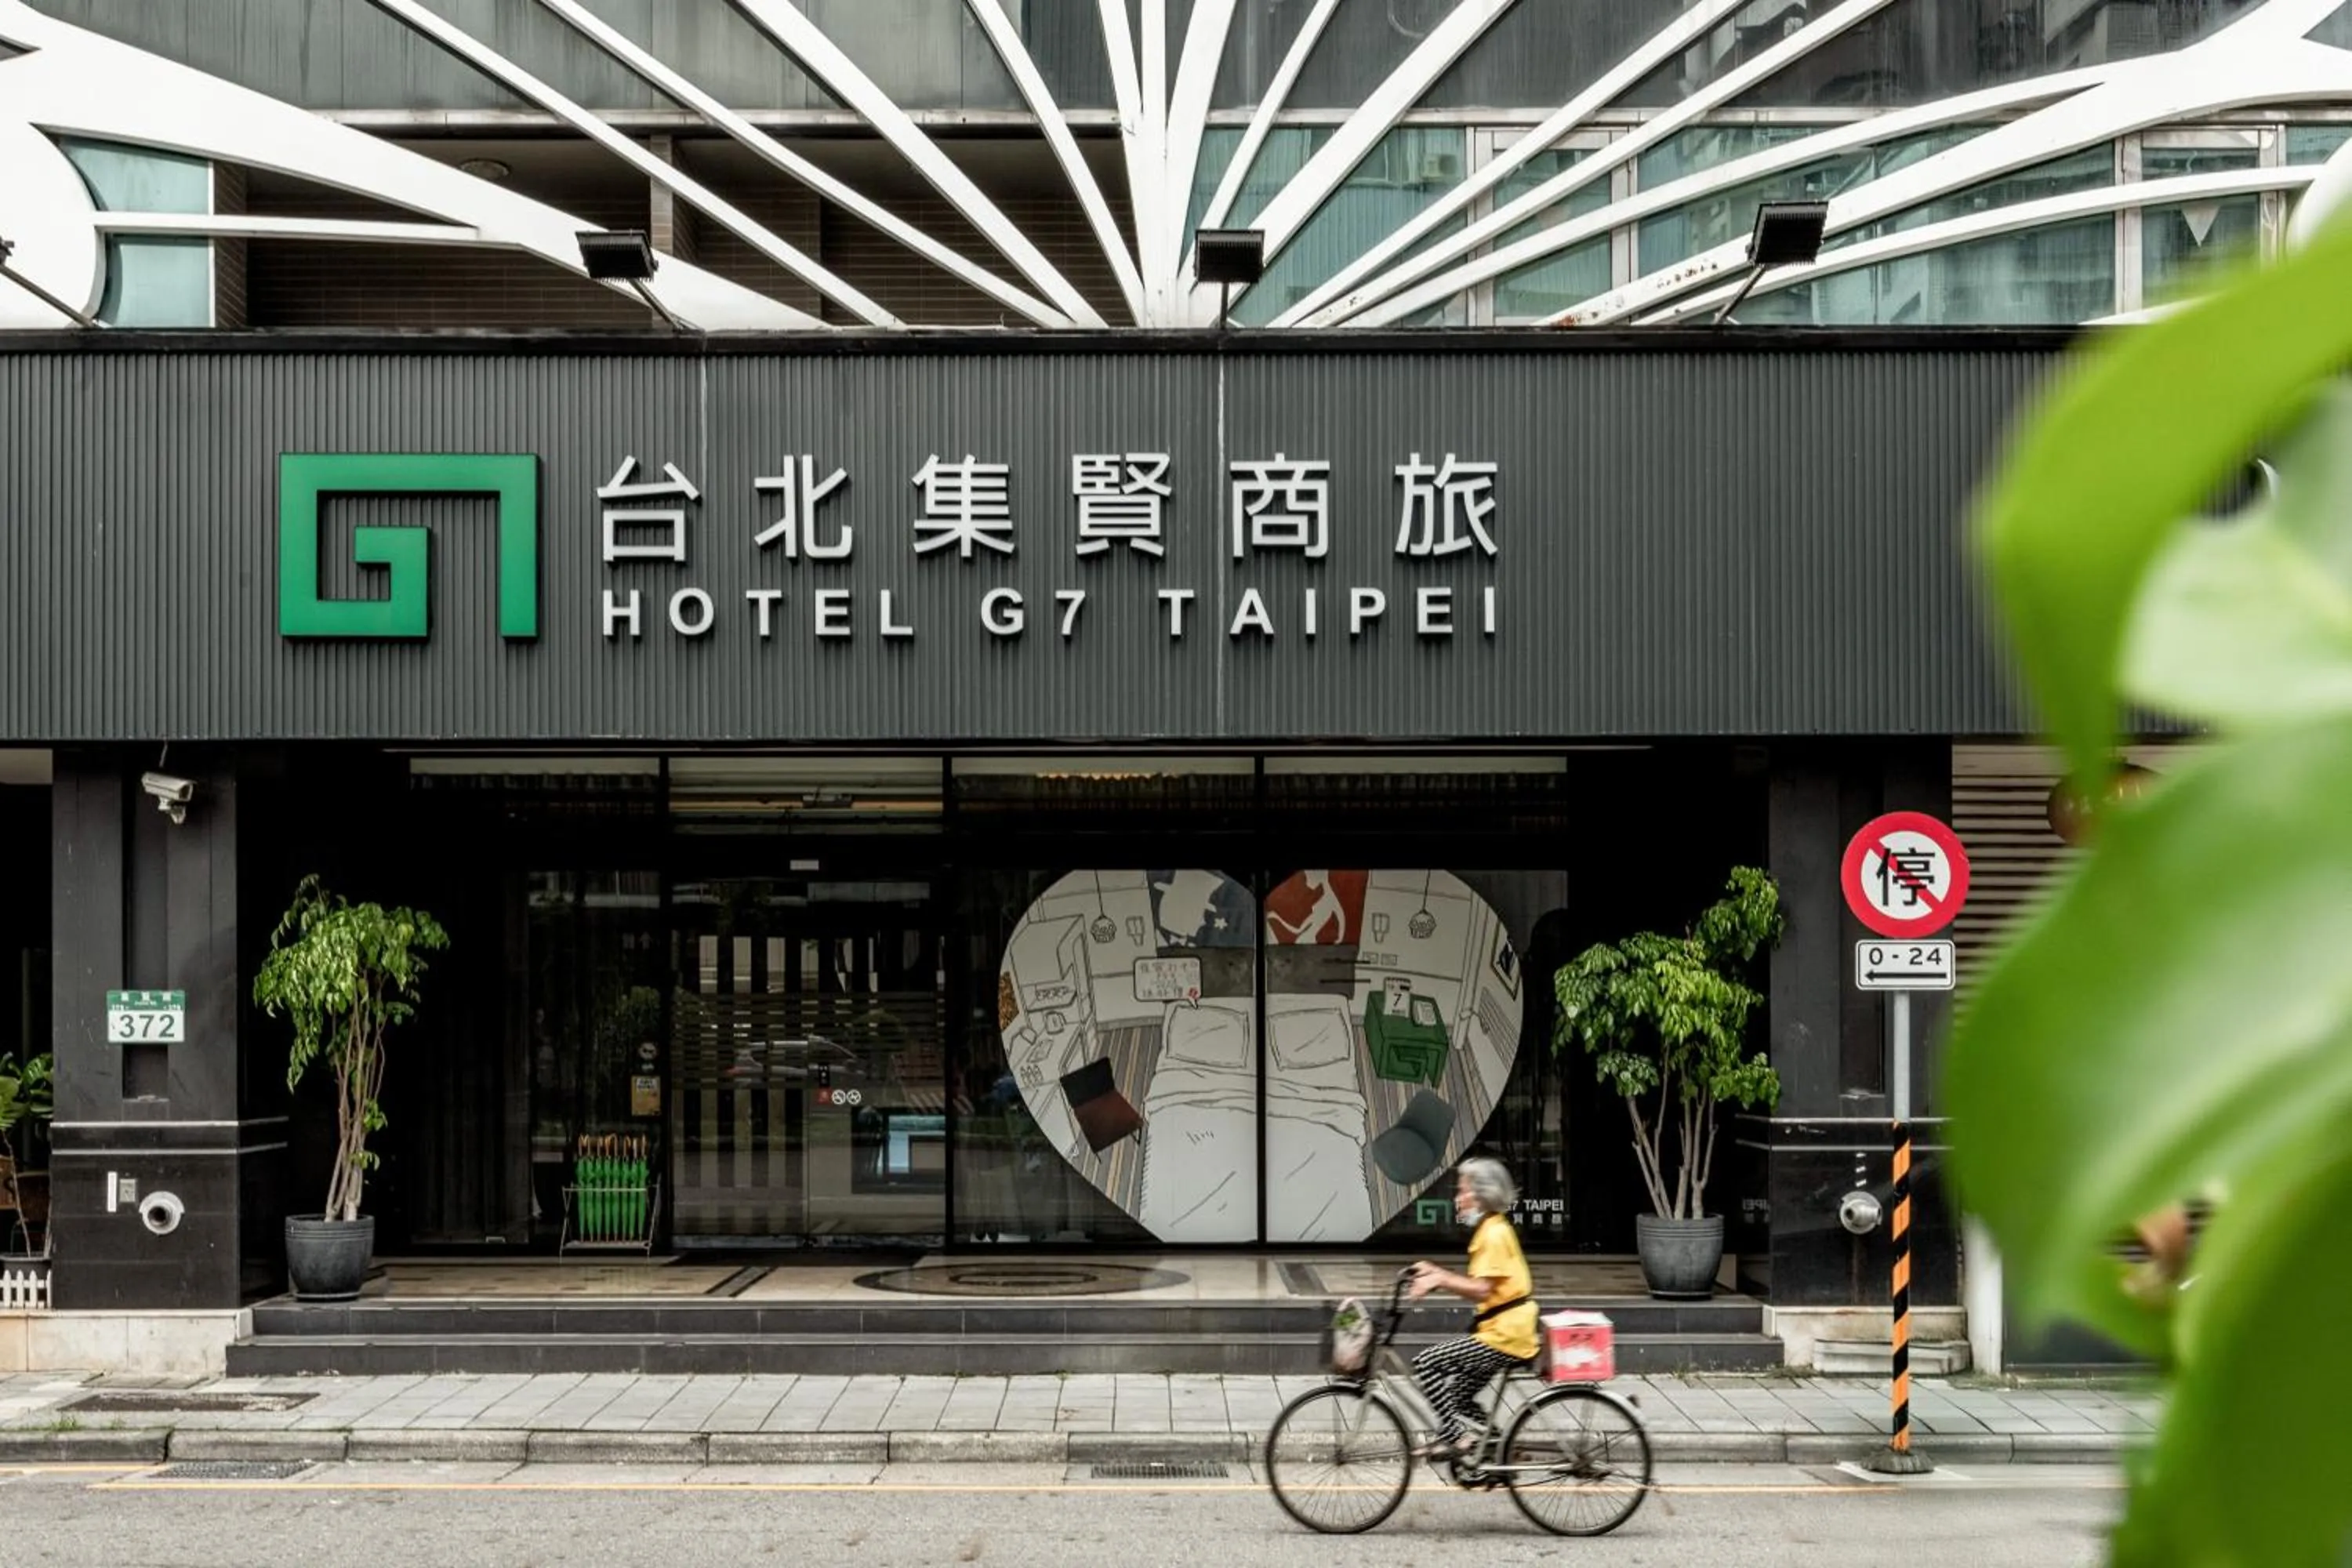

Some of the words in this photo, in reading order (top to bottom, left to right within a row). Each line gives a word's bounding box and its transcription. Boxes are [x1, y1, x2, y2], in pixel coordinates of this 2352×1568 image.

[596, 452, 1499, 562] 台北集賢商旅
[602, 587, 914, 636] HOTEL
[981, 586, 1087, 635] G7
[1157, 586, 1496, 635] TAIPEI
[1876, 848, 1936, 906] 停
[1909, 947, 1942, 965] 24
[119, 1014, 175, 1038] 372
[1523, 1199, 1565, 1211] TAIPEI
